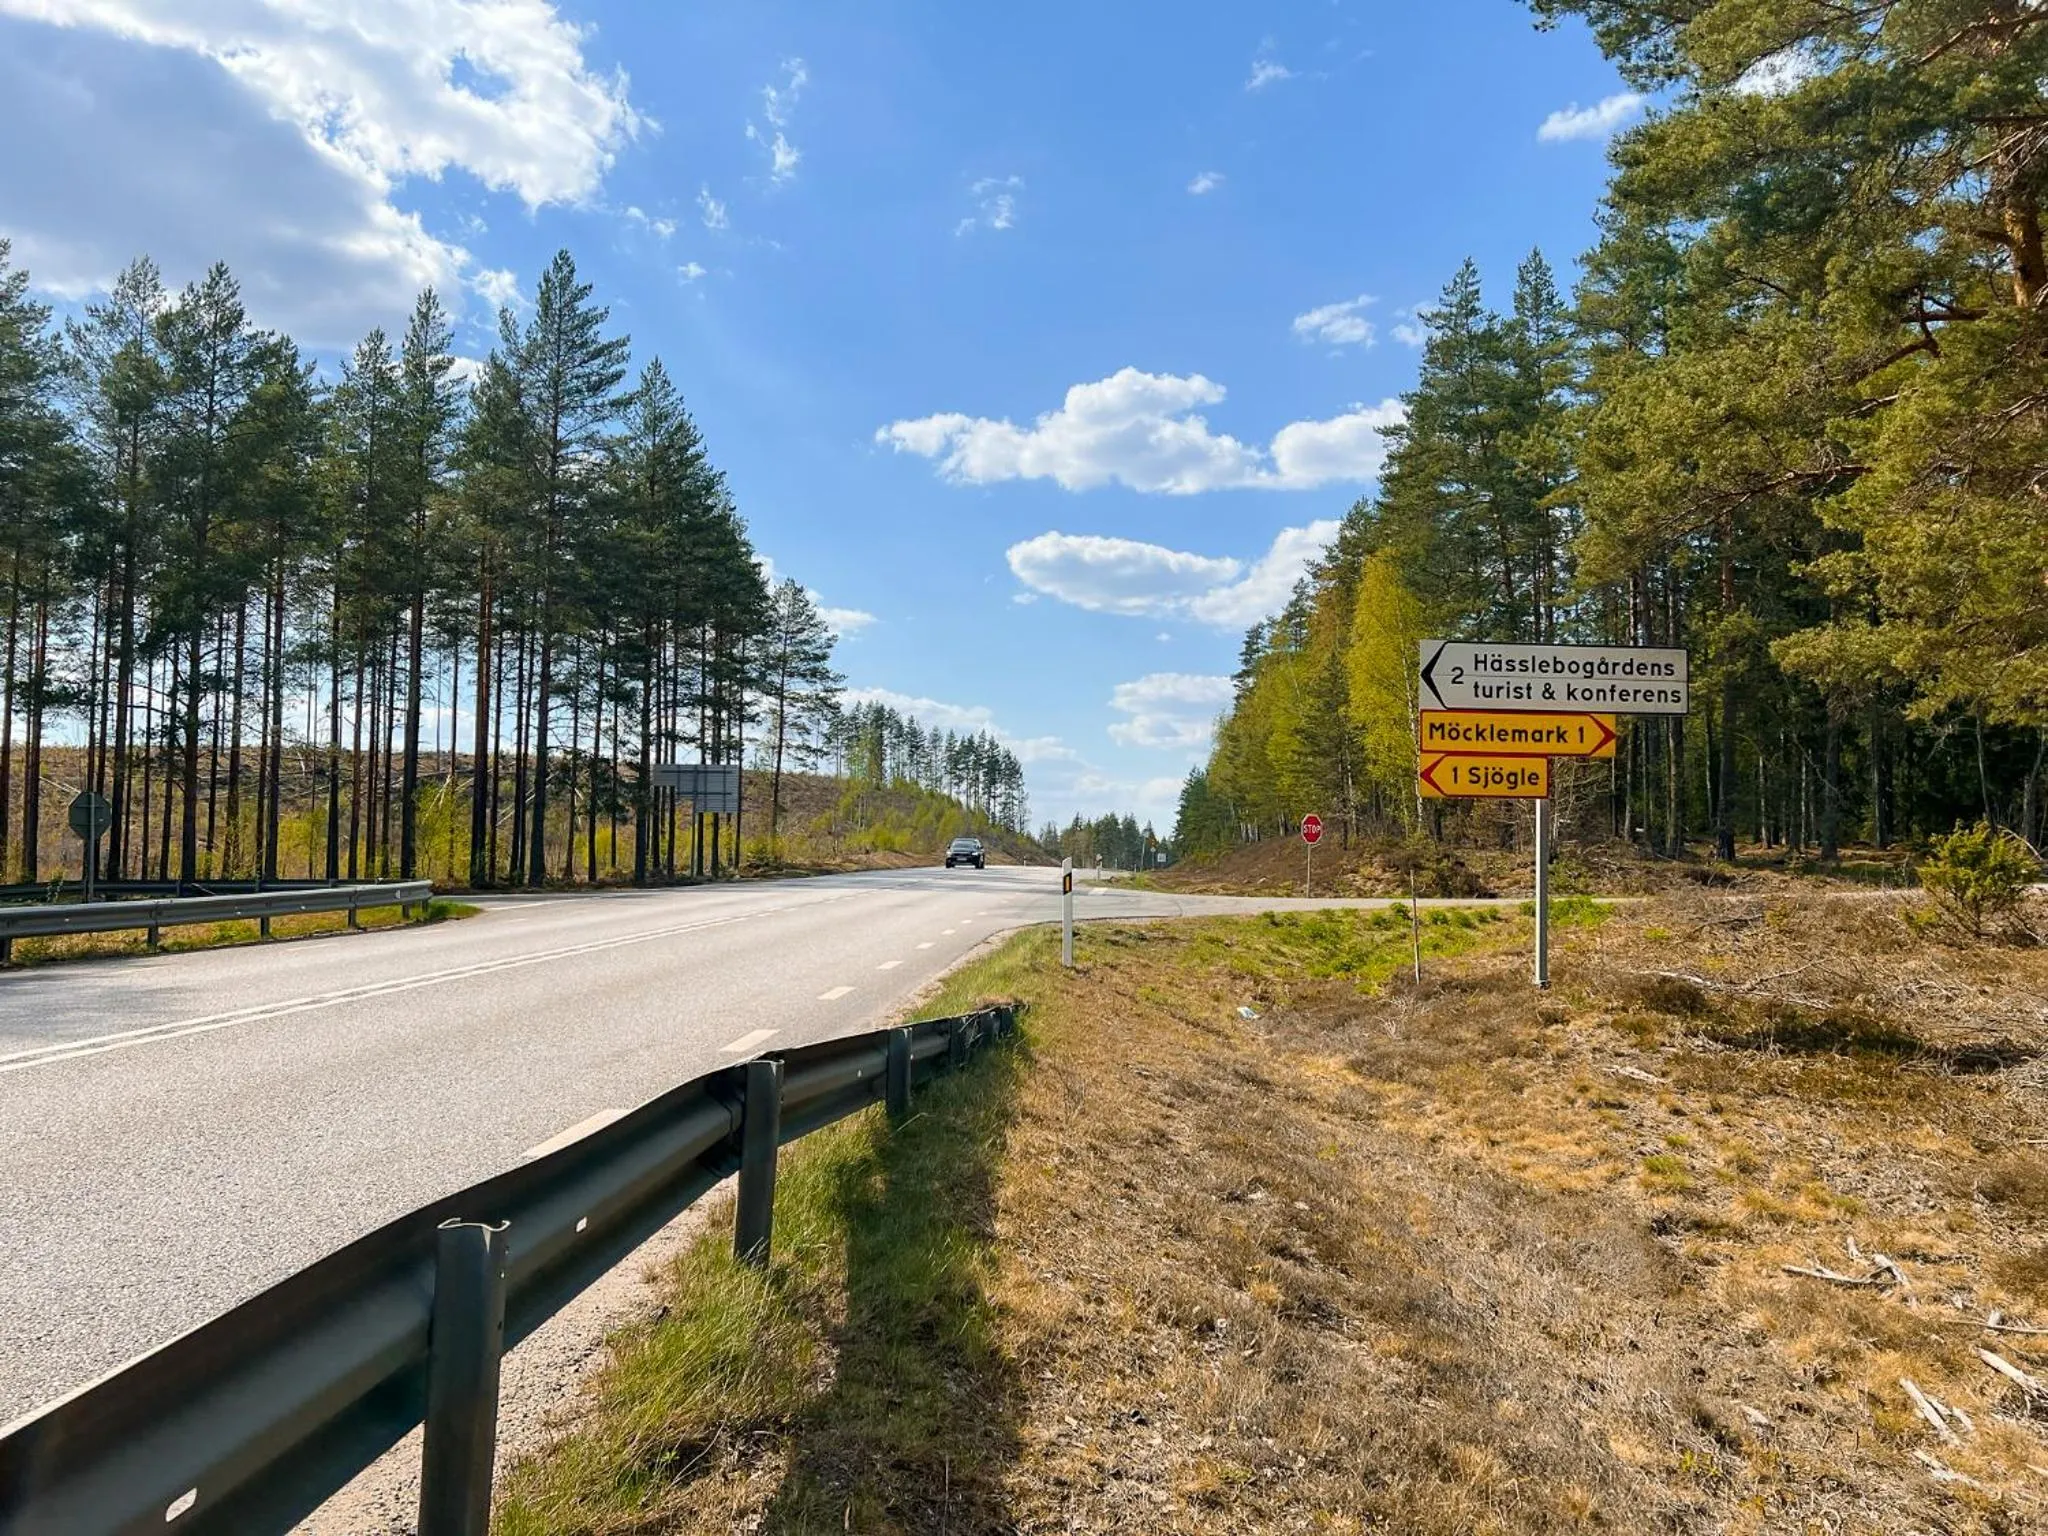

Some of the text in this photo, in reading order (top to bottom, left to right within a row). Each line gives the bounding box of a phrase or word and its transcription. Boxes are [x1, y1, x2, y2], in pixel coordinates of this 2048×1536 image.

[1451, 667, 1464, 685] 2
[1474, 653, 1675, 679] Hässlebogårdens
[1473, 681, 1682, 703] turist & konferens
[1429, 722, 1585, 744] Möcklemark 1
[1452, 767, 1540, 790] 1 Sjögle
[1303, 824, 1321, 834] STOP
